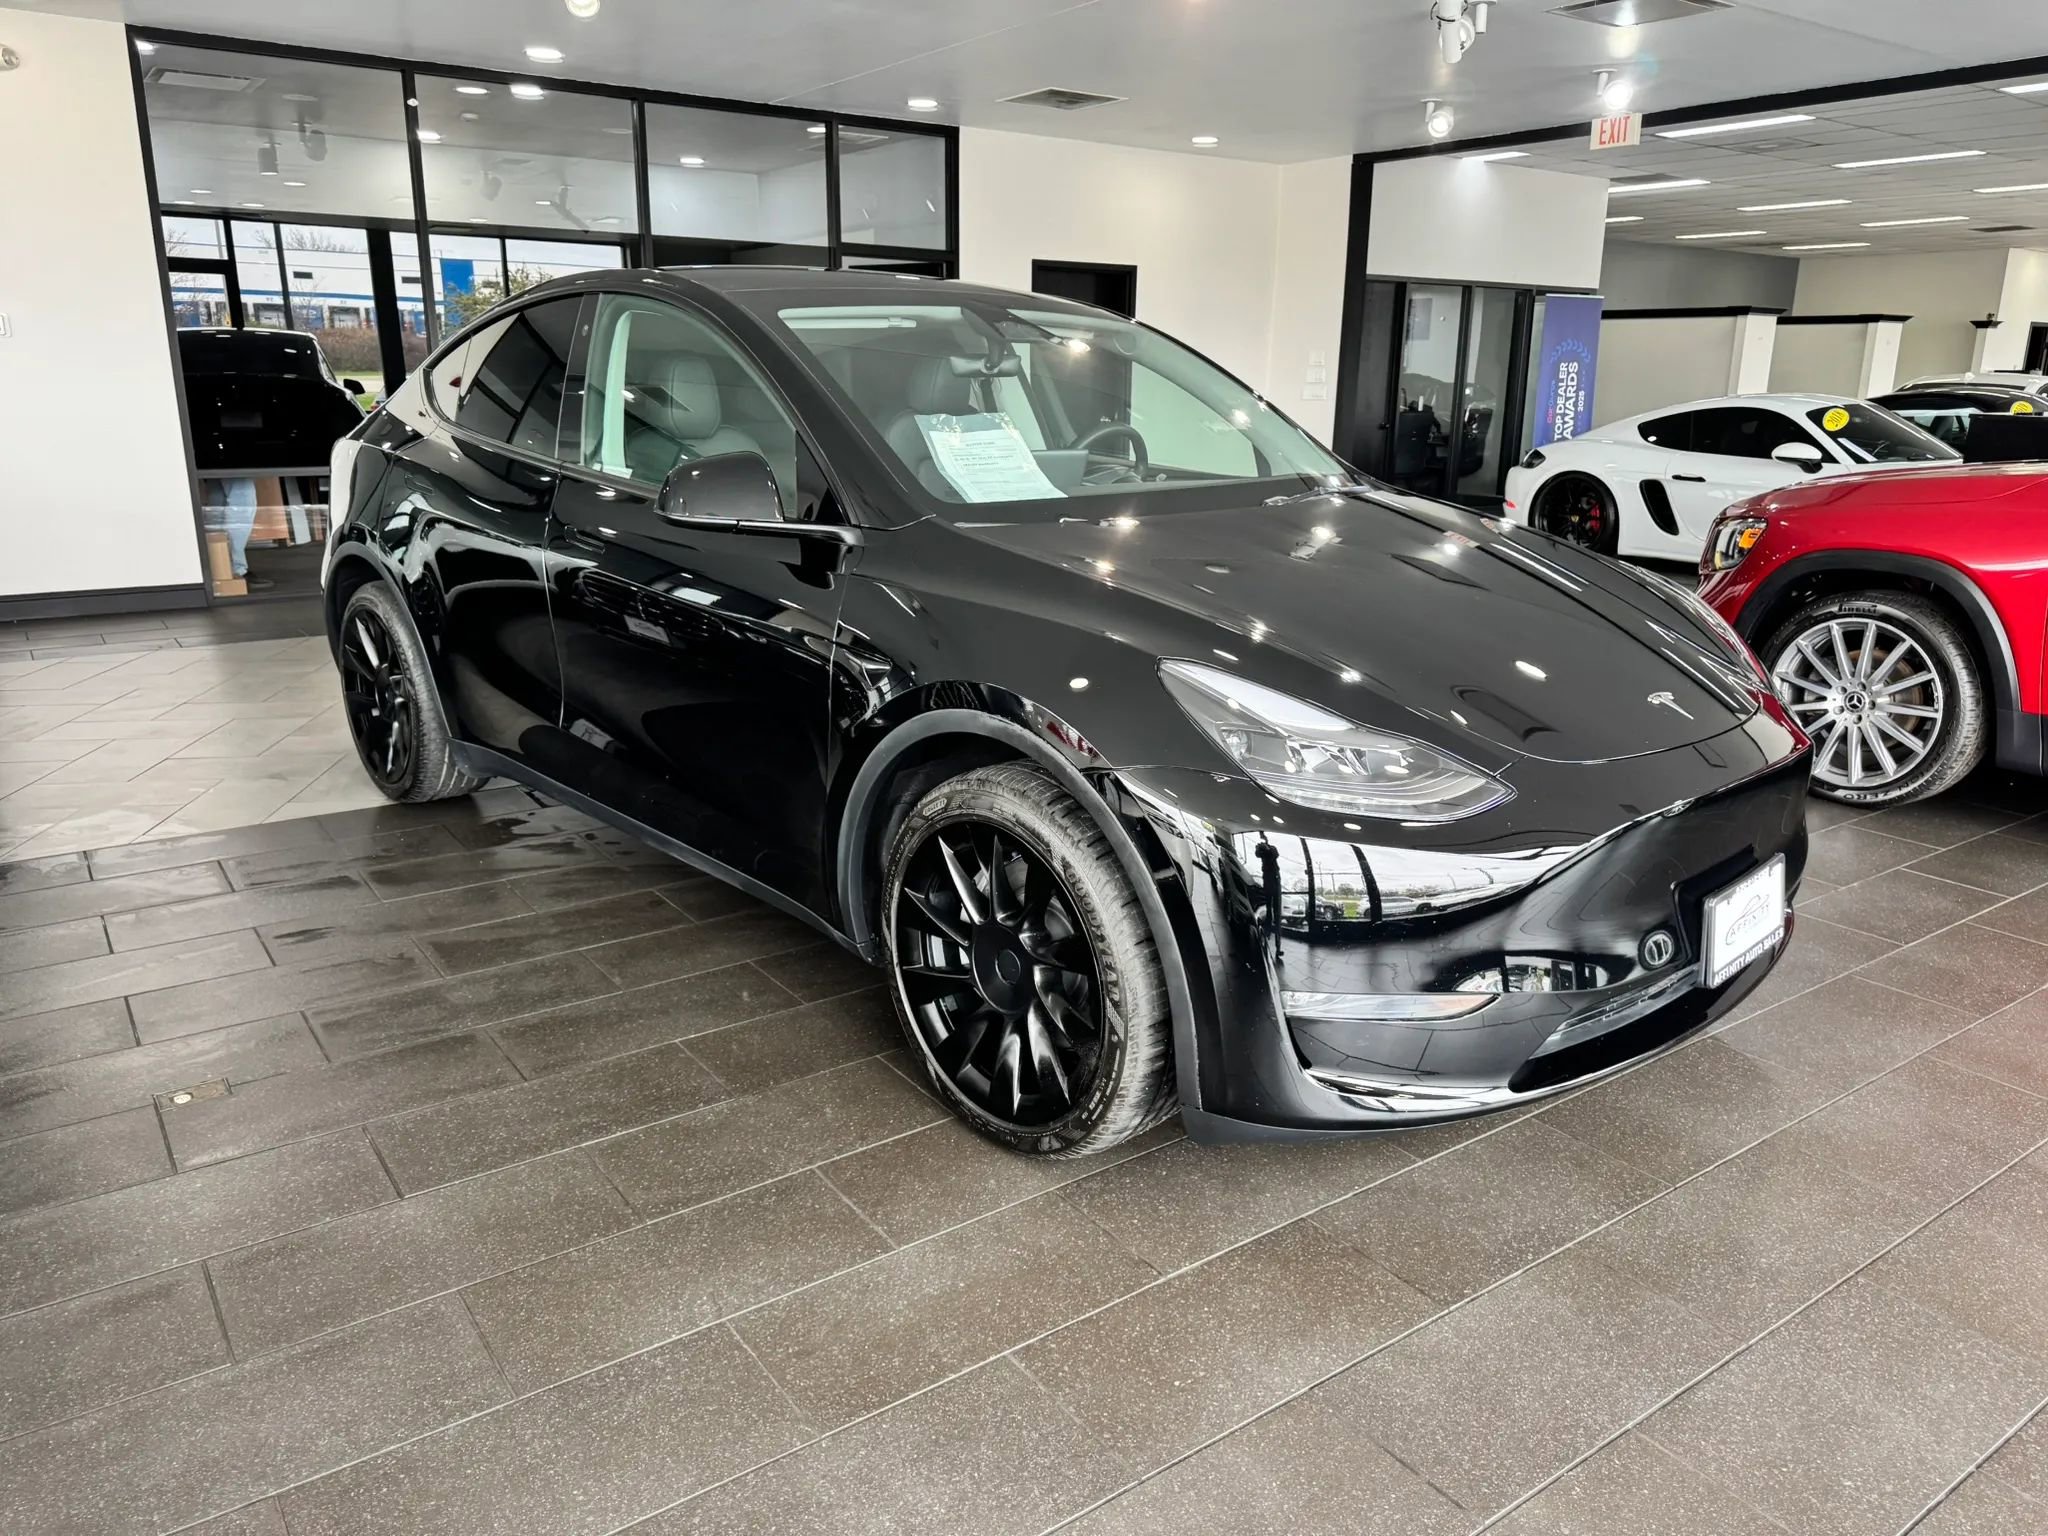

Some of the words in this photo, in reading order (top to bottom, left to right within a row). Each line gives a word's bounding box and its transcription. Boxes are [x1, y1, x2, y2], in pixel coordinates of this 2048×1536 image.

[1599, 115, 1631, 145] EXIT
[1556, 362, 1568, 414] DEALER
[1563, 361, 1578, 440] AWARDS
[1554, 415, 1564, 441] TOP
[1714, 955, 1746, 986] AFFINITY
[1745, 941, 1764, 964] AUTO
[1763, 927, 1785, 952] SALES
